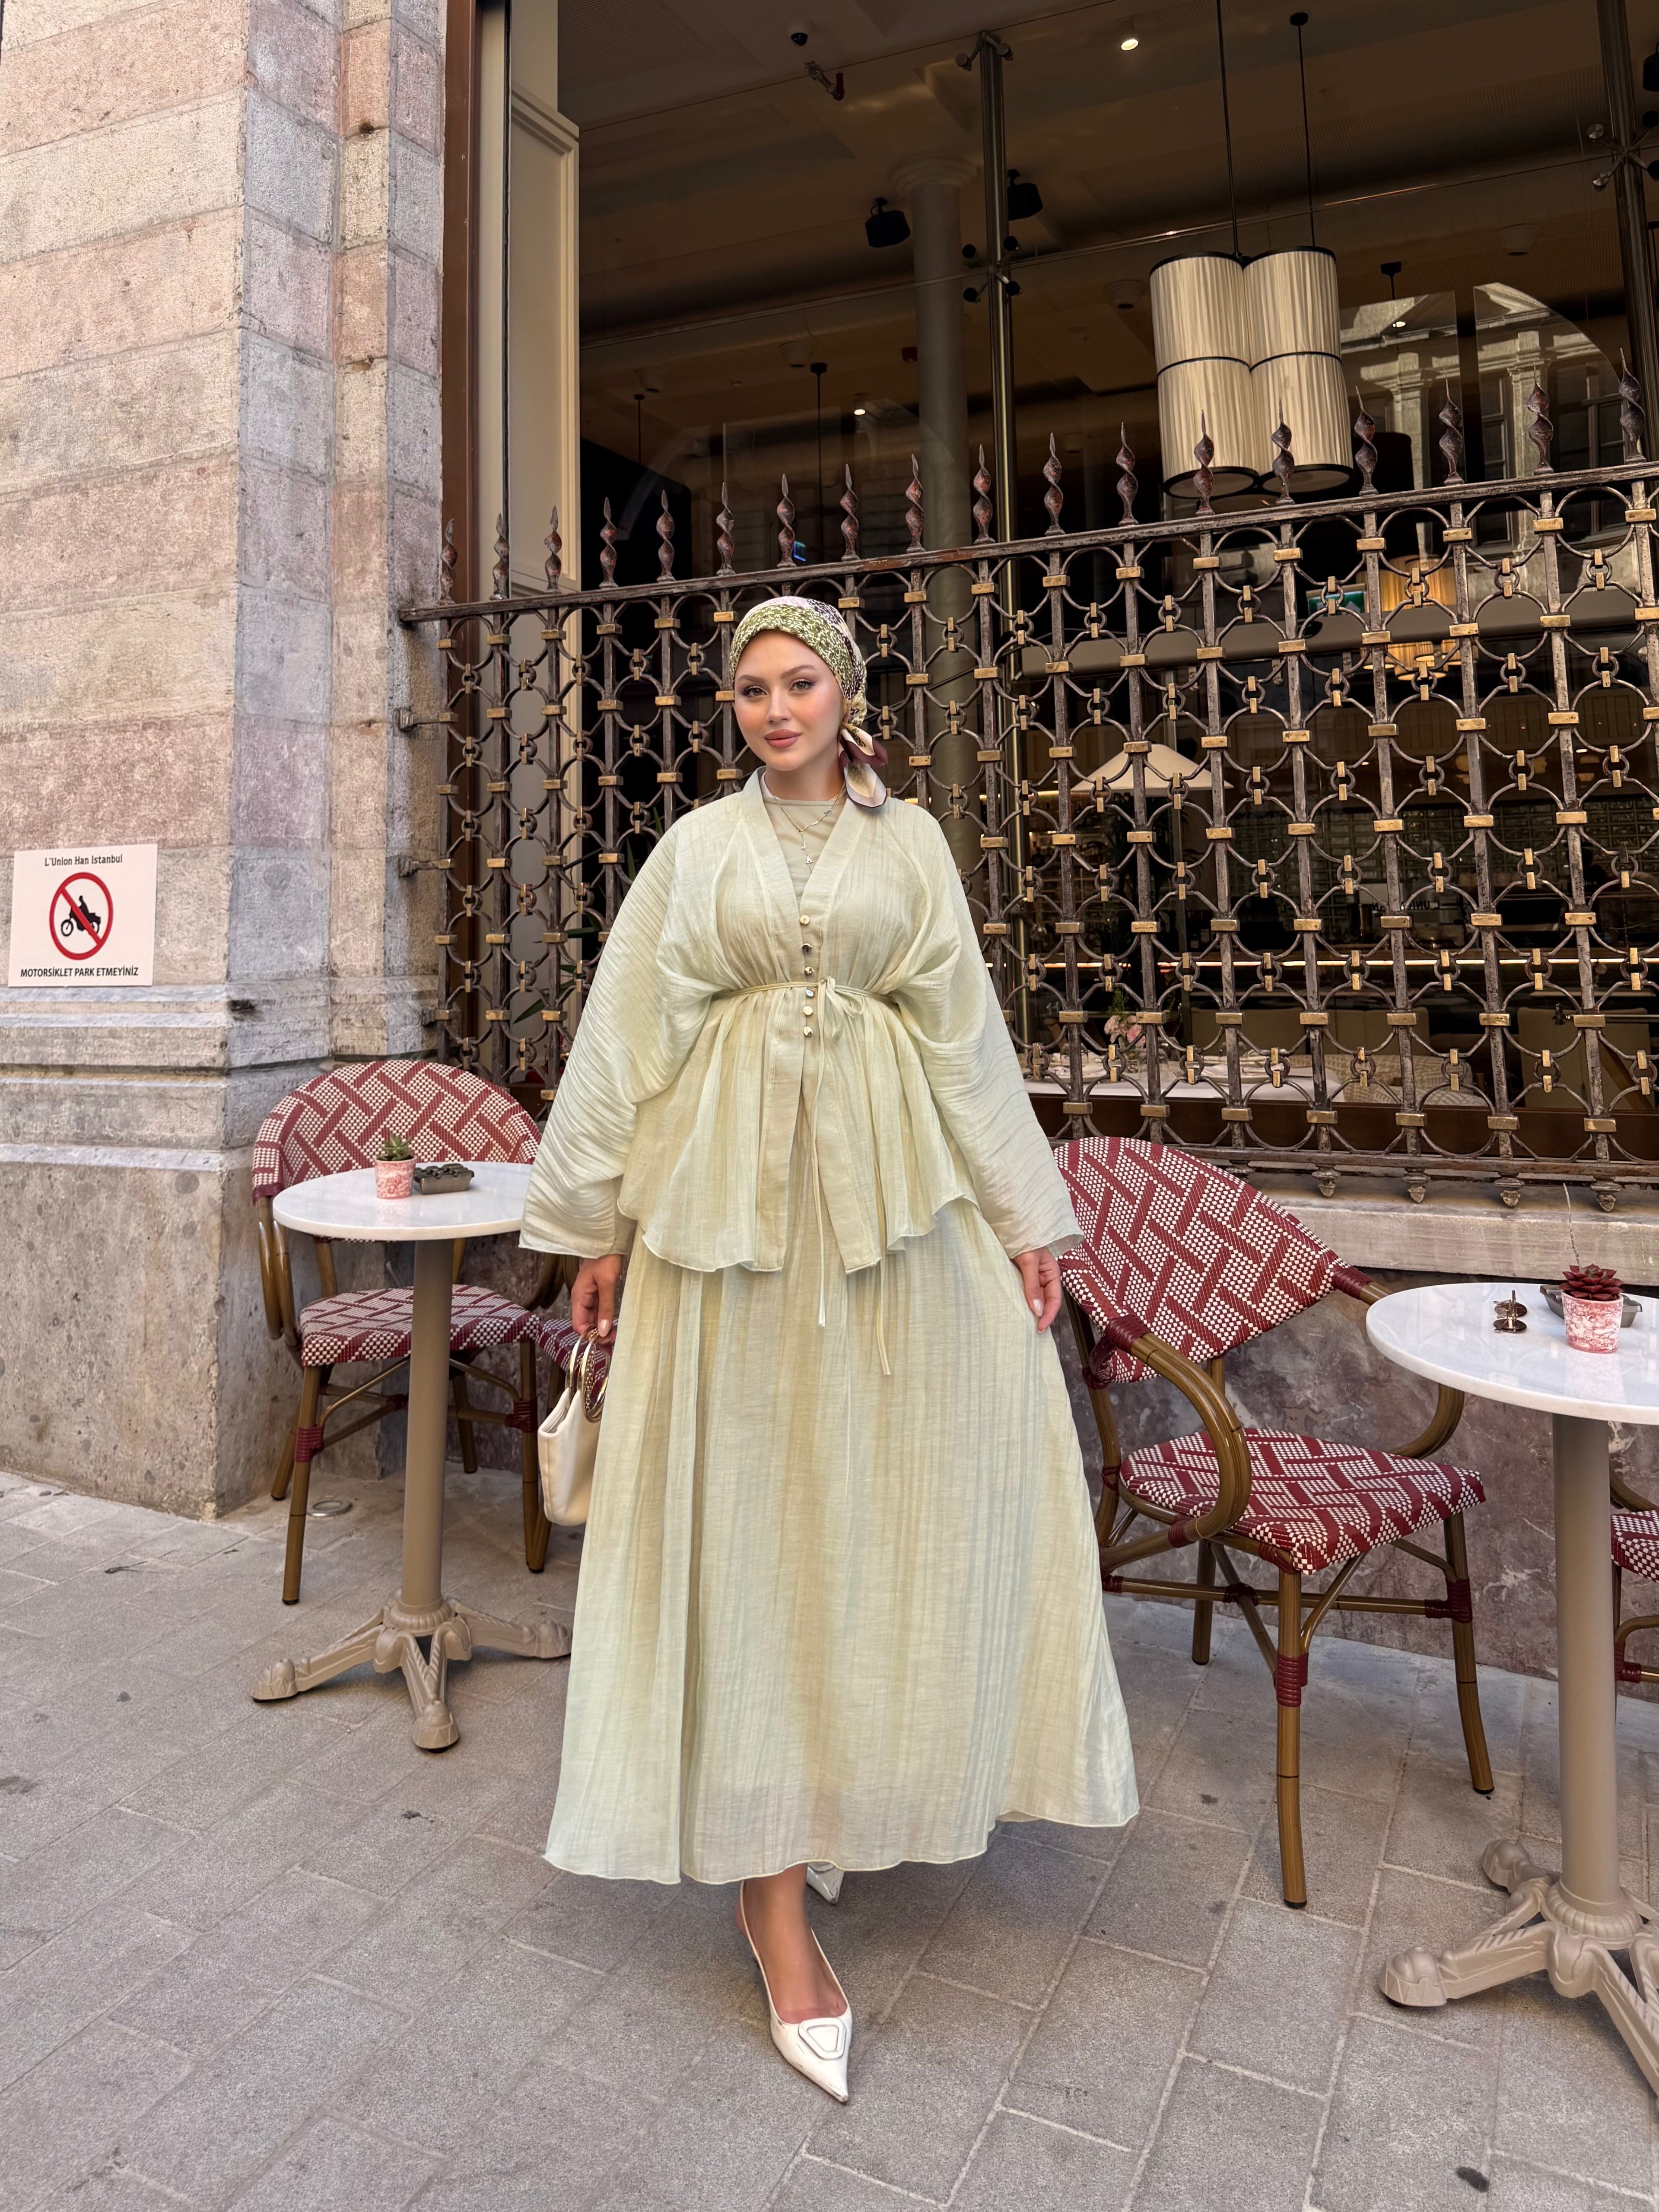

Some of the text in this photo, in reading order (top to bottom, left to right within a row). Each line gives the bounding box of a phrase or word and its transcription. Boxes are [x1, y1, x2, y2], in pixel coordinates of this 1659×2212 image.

[75, 856, 89, 865] Han
[92, 854, 123, 864] Istanbul
[20, 966, 139, 977] MOTORSİKLET PARK ETMEYİNİZ
